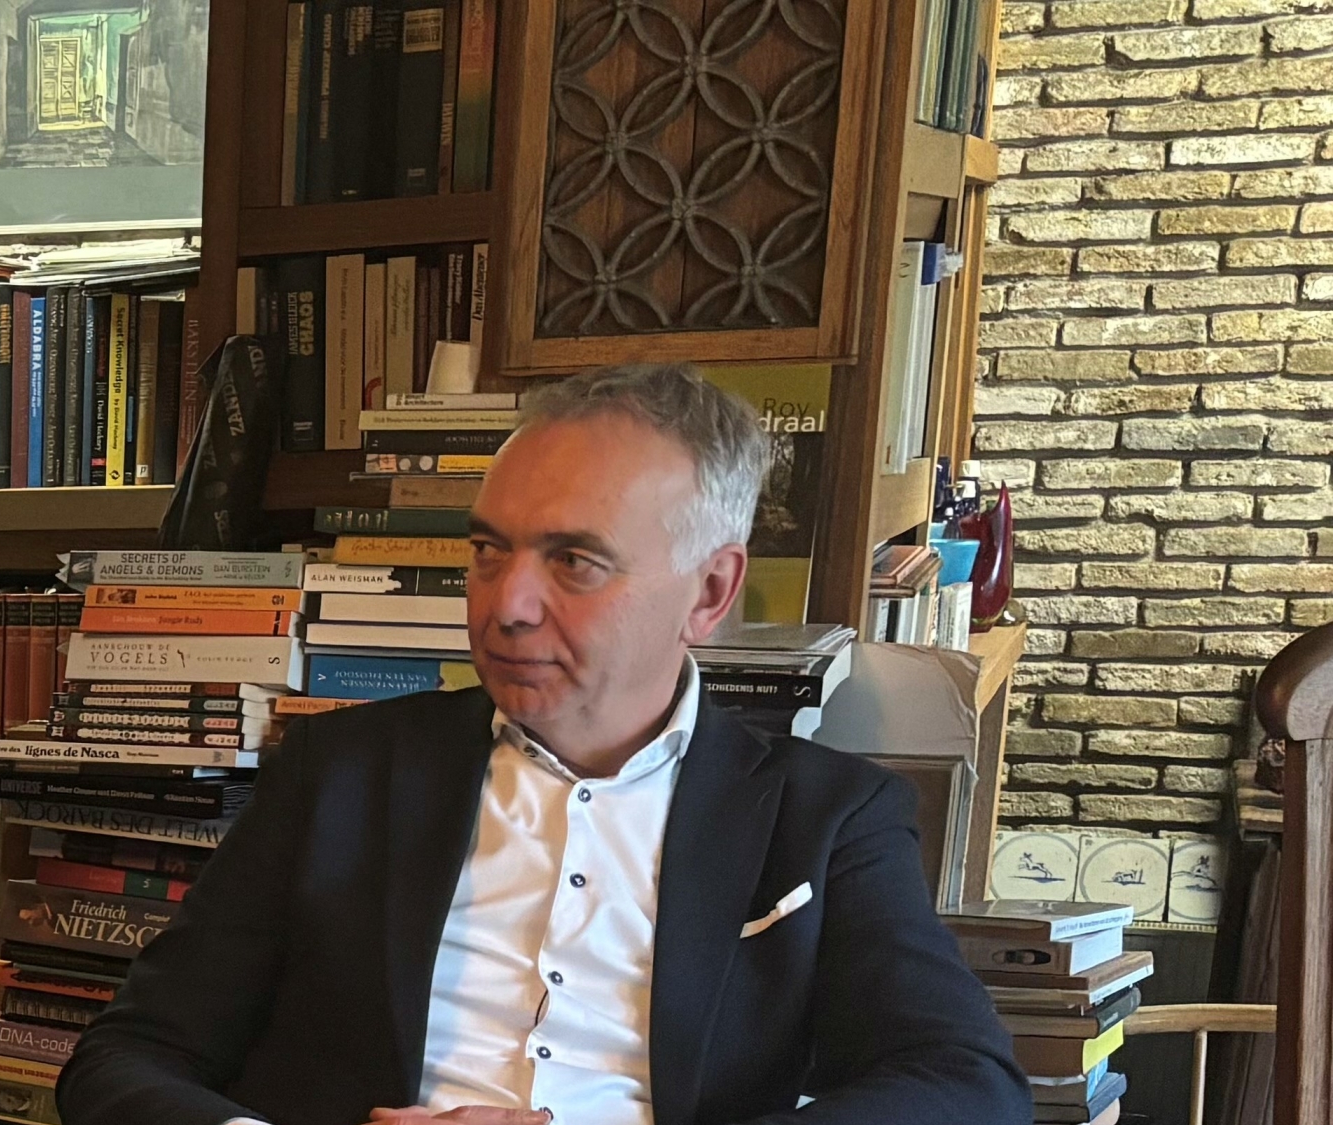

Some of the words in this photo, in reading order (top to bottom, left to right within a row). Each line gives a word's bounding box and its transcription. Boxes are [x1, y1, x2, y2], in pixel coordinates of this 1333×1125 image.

[115, 307, 126, 337] Secret
[299, 290, 314, 357] CHAOS
[32, 309, 43, 370] ALDABRA
[287, 325, 299, 356] JAMES
[113, 340, 125, 394] Knowledge
[95, 400, 104, 420] David
[93, 422, 104, 452] Hockney
[121, 553, 170, 564] SECRETS
[172, 553, 186, 564] OF
[213, 563, 230, 573] DAN
[232, 563, 271, 573] BURSTEIN
[100, 565, 144, 575] ANGELS
[146, 565, 154, 575] &
[158, 565, 204, 576] DEMONS
[311, 574, 335, 582] ALAN
[339, 575, 384, 584] WEISMAN
[90, 652, 168, 664] VOGELS
[25, 745, 61, 759] lignes
[64, 746, 79, 758] de
[81, 746, 120, 760] Nasca
[16, 800, 102, 826] BAROCK
[108, 815, 154, 835] DES
[71, 899, 127, 920] Friedrich
[53, 912, 164, 948] NIETZSC
[0, 1027, 76, 1054] DNA-code
